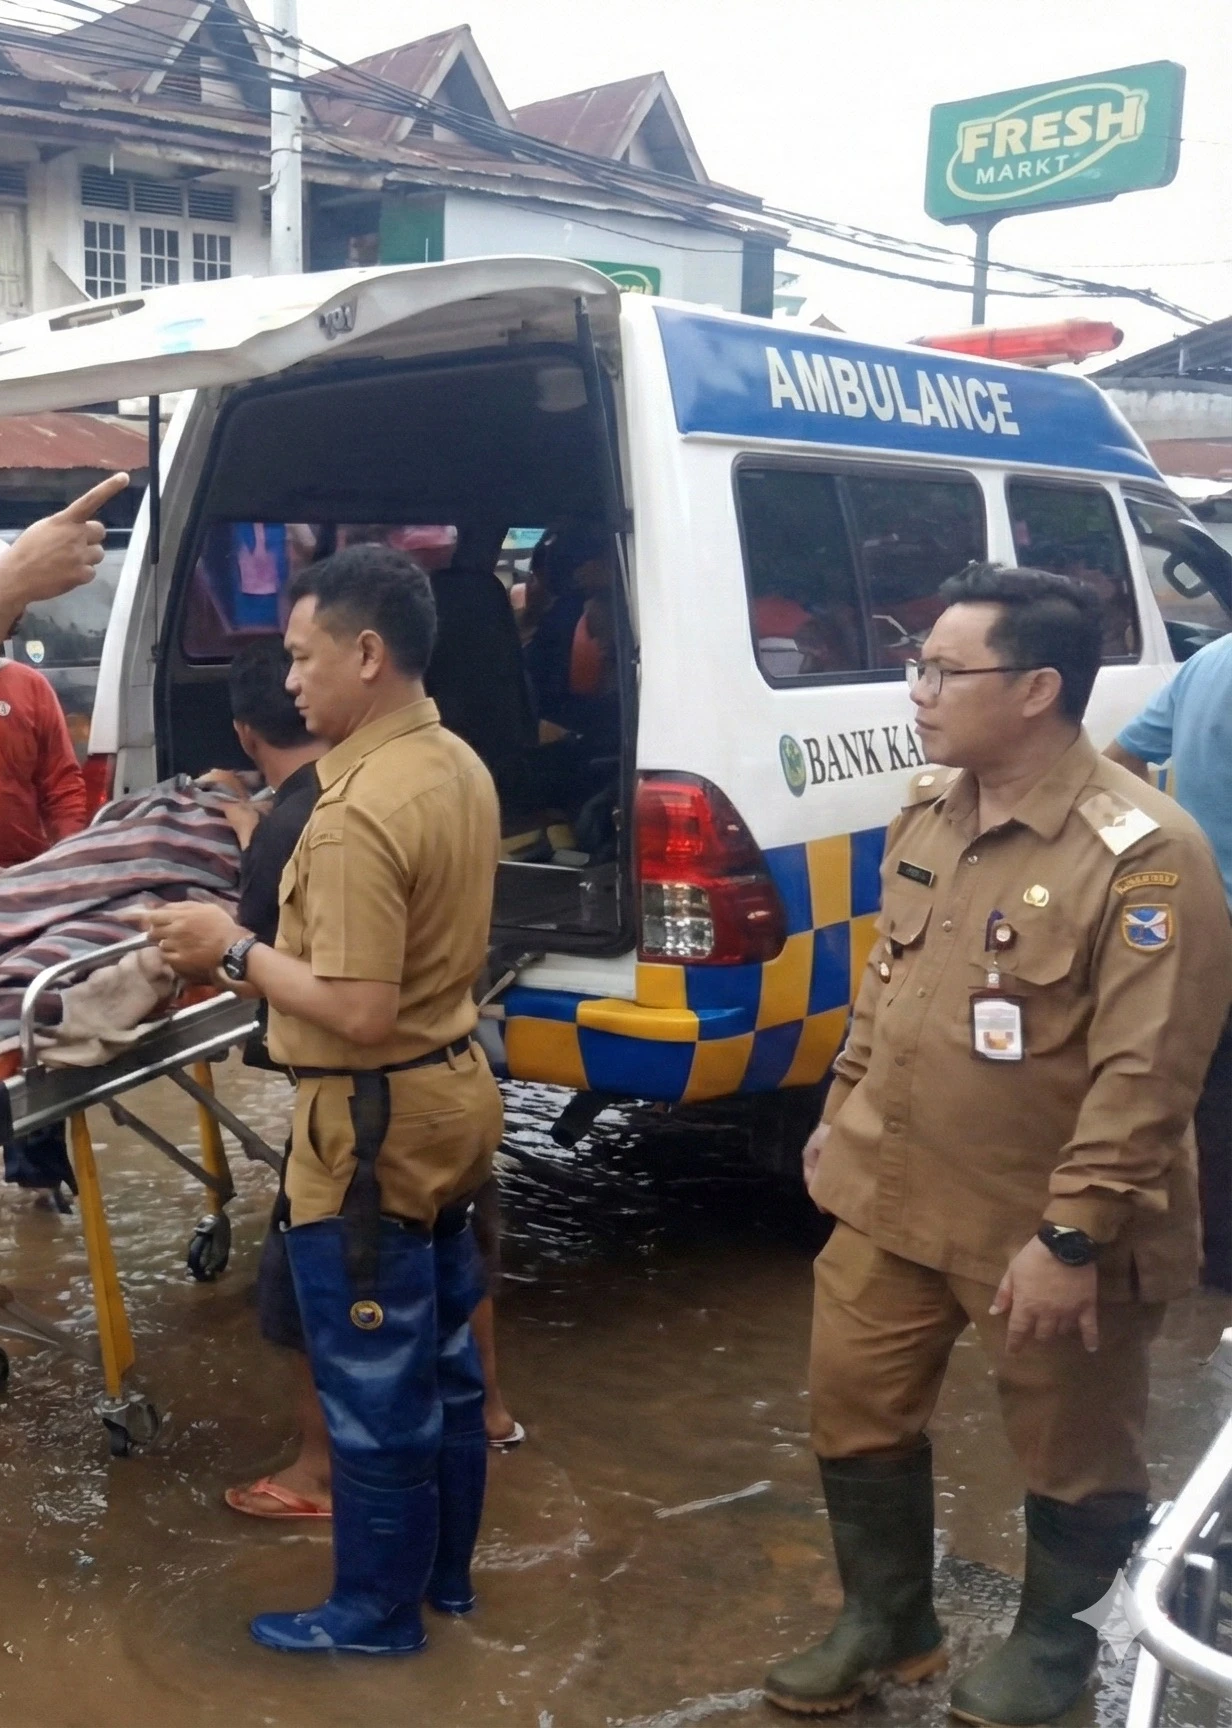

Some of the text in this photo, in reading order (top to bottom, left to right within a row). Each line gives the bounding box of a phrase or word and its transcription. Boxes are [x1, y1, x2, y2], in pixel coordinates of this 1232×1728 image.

[961, 95, 1144, 164] FRESH
[975, 154, 1070, 185] MARKT
[765, 346, 1021, 436] AMBULANCE
[803, 723, 926, 785] BANK KA
